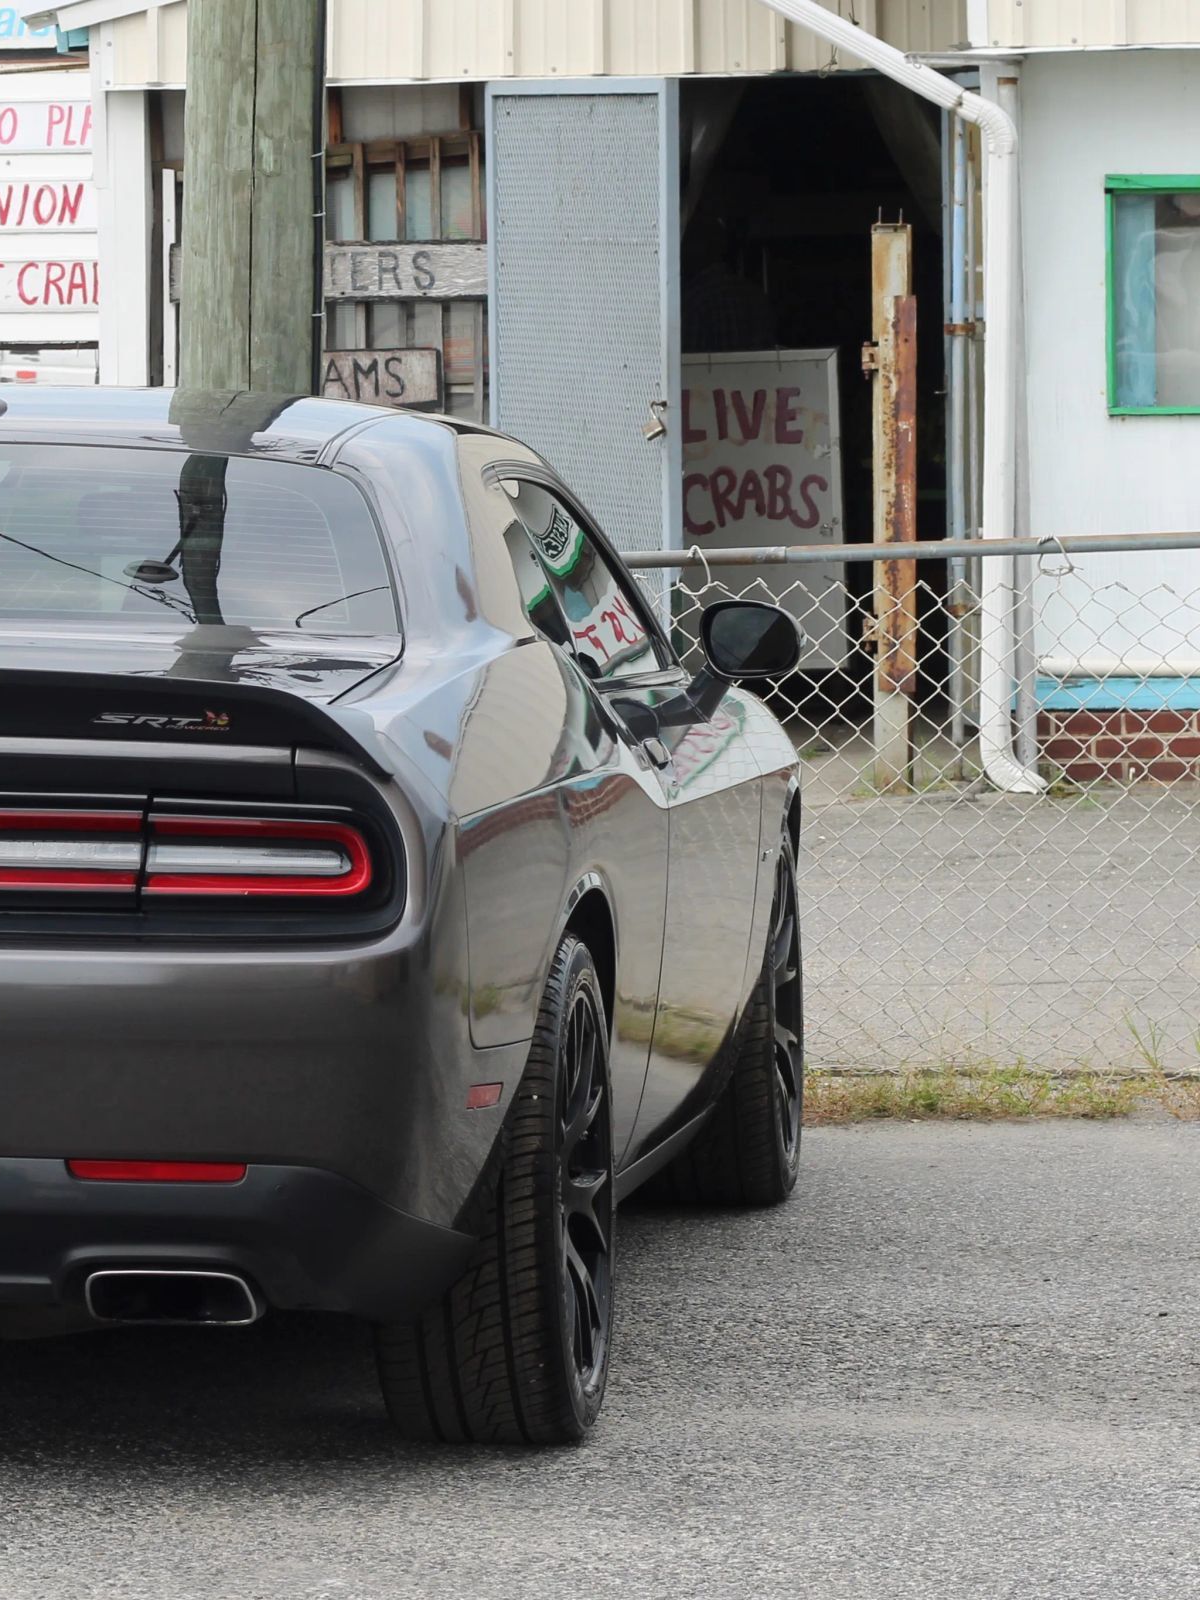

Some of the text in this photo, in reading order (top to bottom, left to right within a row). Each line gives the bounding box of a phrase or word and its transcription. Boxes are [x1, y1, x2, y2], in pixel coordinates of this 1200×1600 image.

[322, 356, 405, 401] AMS
[681, 386, 804, 444] LIVE
[682, 464, 829, 536] CRABS
[93, 713, 203, 728] SRT
